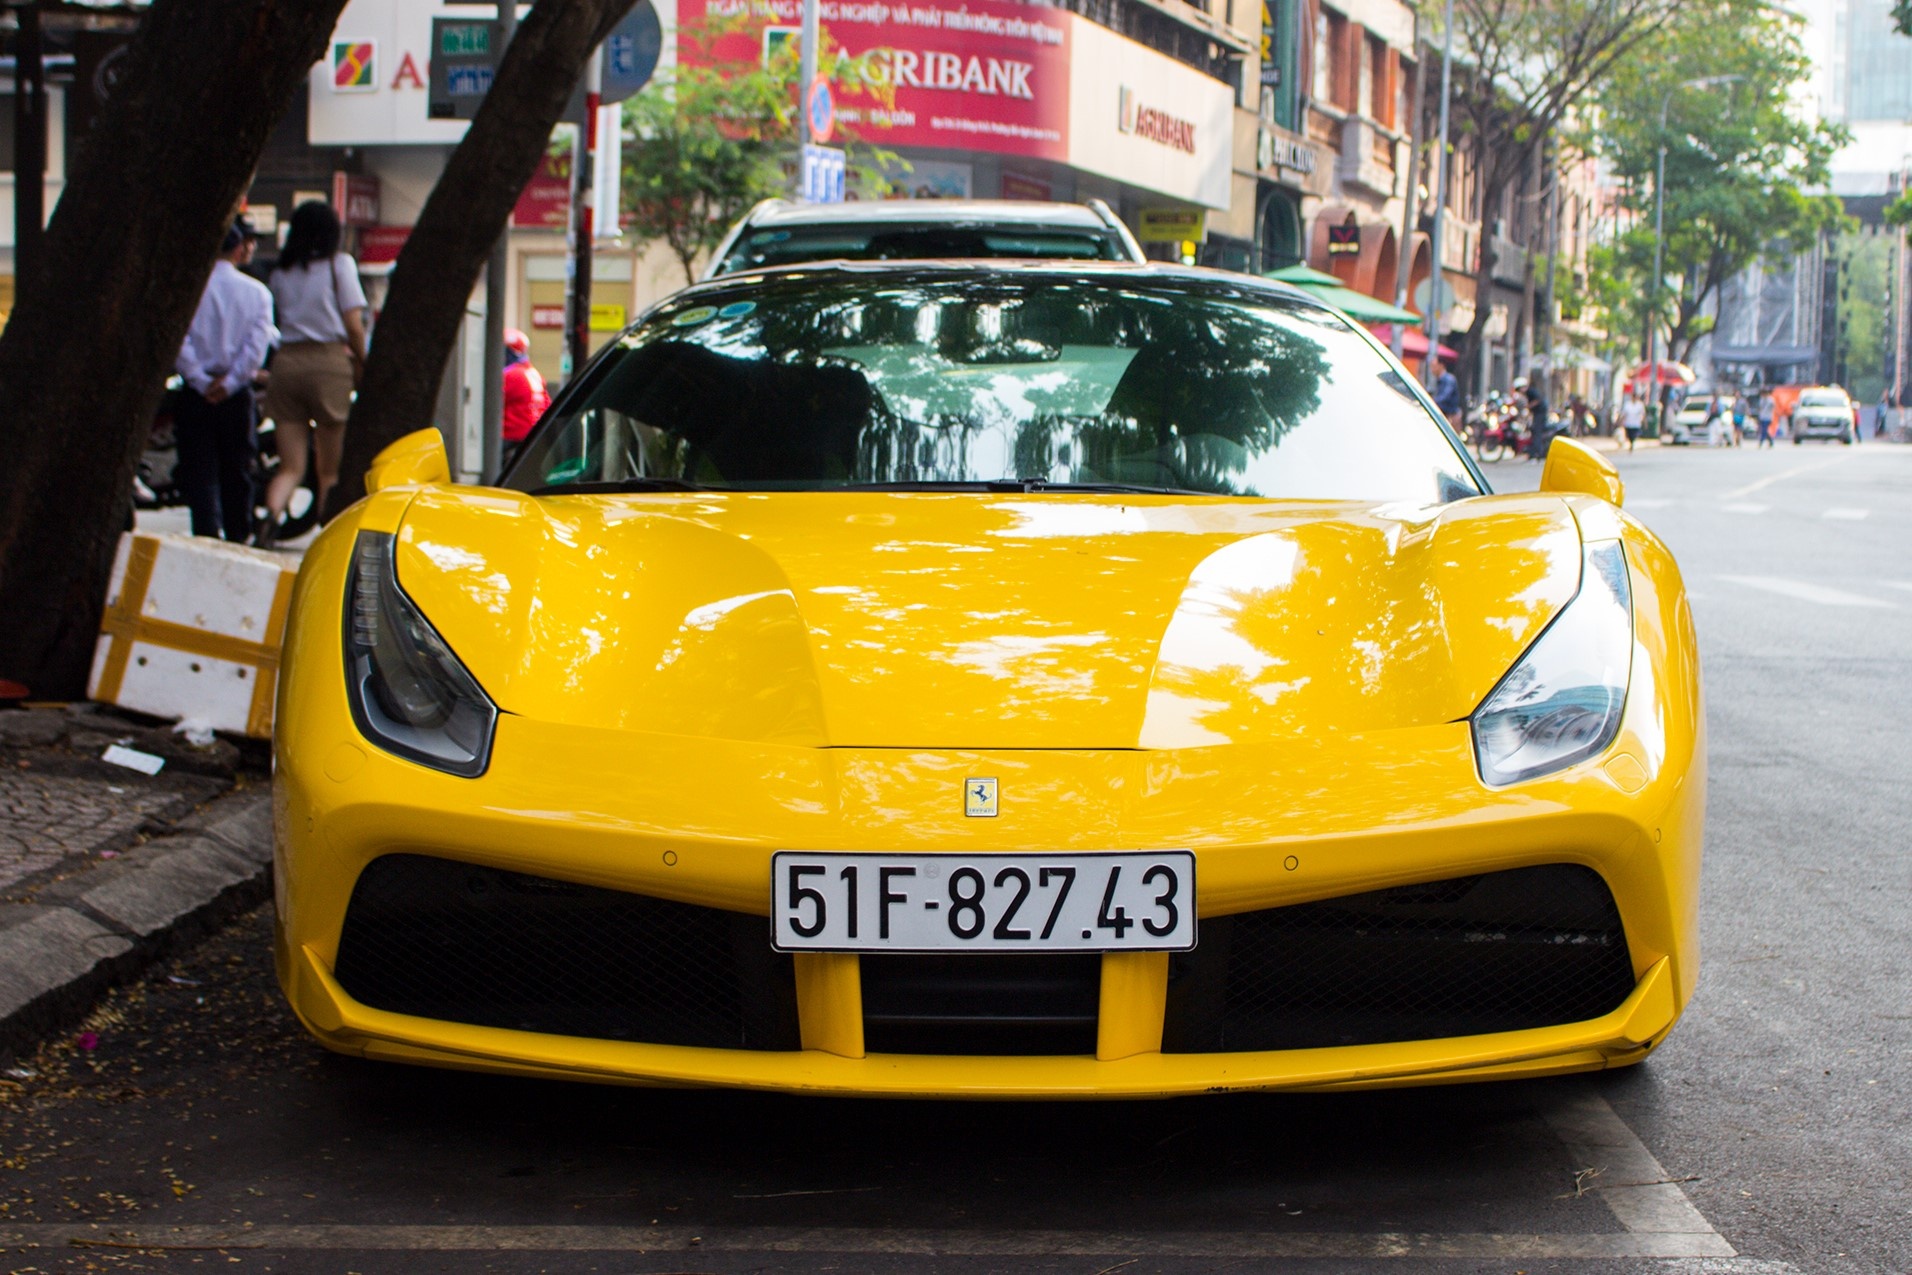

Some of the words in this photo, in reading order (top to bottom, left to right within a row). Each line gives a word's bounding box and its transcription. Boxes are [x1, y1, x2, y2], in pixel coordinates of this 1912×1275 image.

[390, 50, 431, 90] A
[831, 46, 1034, 100] AGRIBANK
[788, 864, 1179, 940] 51F-827.43
